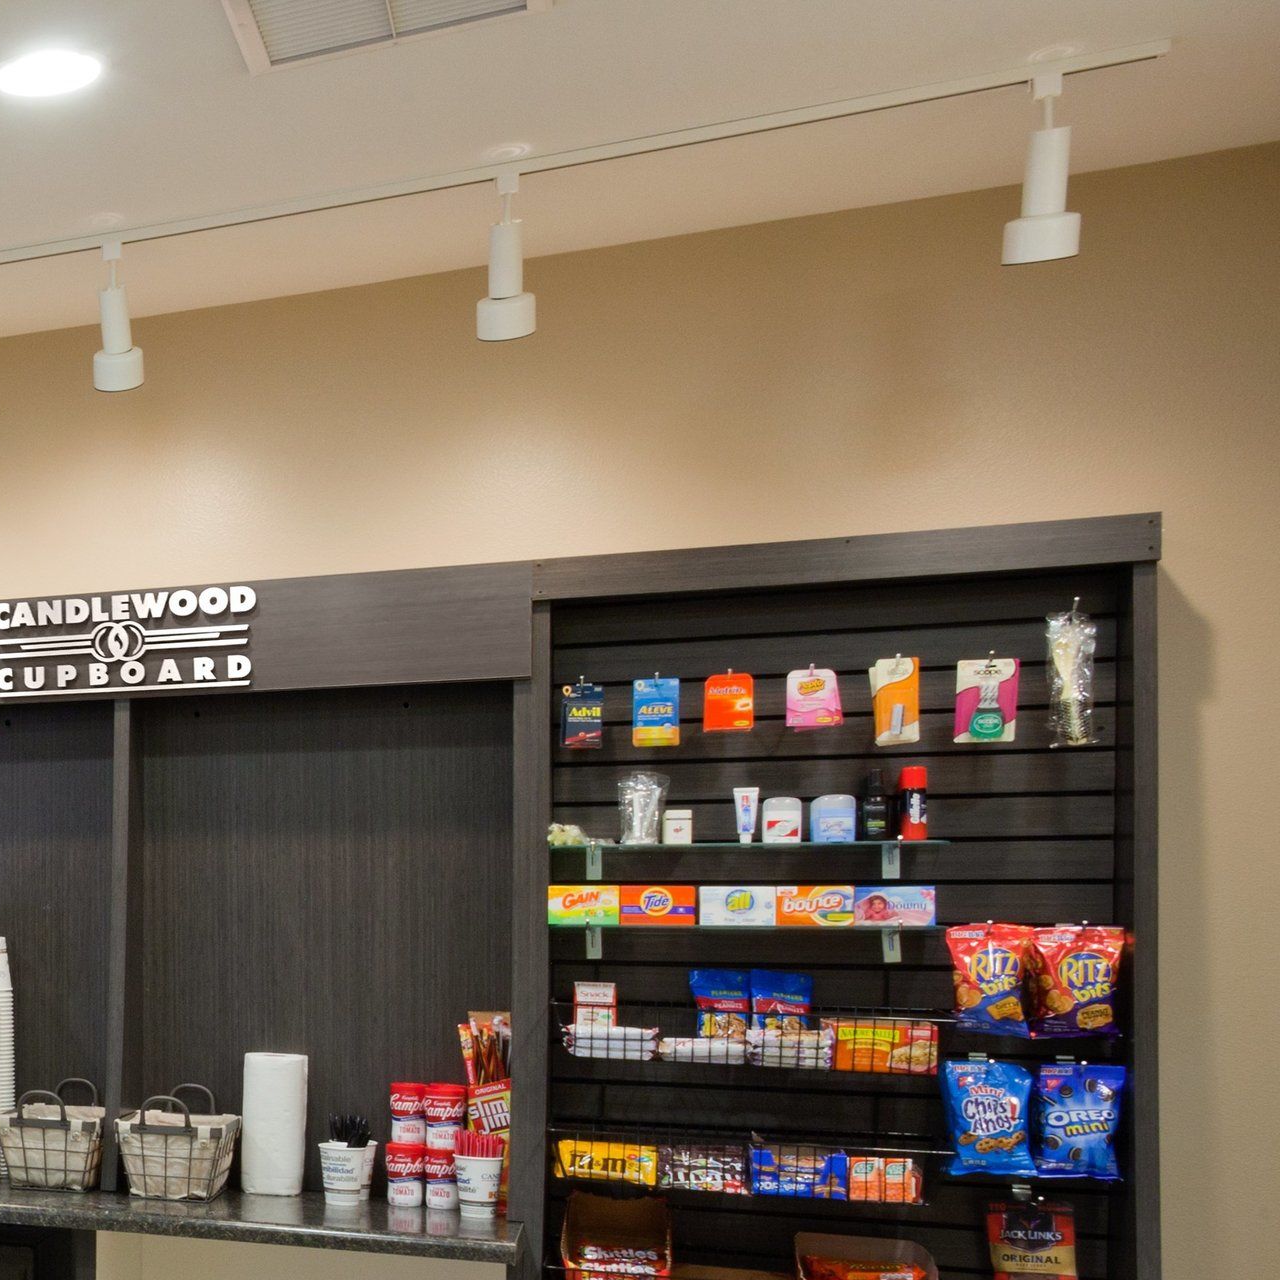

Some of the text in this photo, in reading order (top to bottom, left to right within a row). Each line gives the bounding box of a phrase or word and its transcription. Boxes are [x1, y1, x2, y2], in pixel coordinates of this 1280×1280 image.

[568, 706, 601, 718] Advil
[638, 704, 674, 716] ALEVE
[643, 893, 670, 911] Tide
[726, 890, 751, 912] all
[781, 893, 842, 915] bounce
[969, 950, 1021, 983] RITZ
[1060, 956, 1113, 988] RITZ
[580, 990, 609, 999] Snack
[979, 975, 1018, 997] bits
[1072, 981, 1113, 1003] bits
[474, 1083, 507, 1096] ORIGINAL
[968, 1084, 1006, 1098] Mini
[962, 1097, 1008, 1118] Chips
[1046, 1109, 1116, 1128] OREO
[1064, 1120, 1110, 1138] mini
[1000, 1229, 1027, 1240] JACK
[583, 1245, 658, 1261] Skittles
[1001, 1253, 1061, 1265] ORIGINAL
